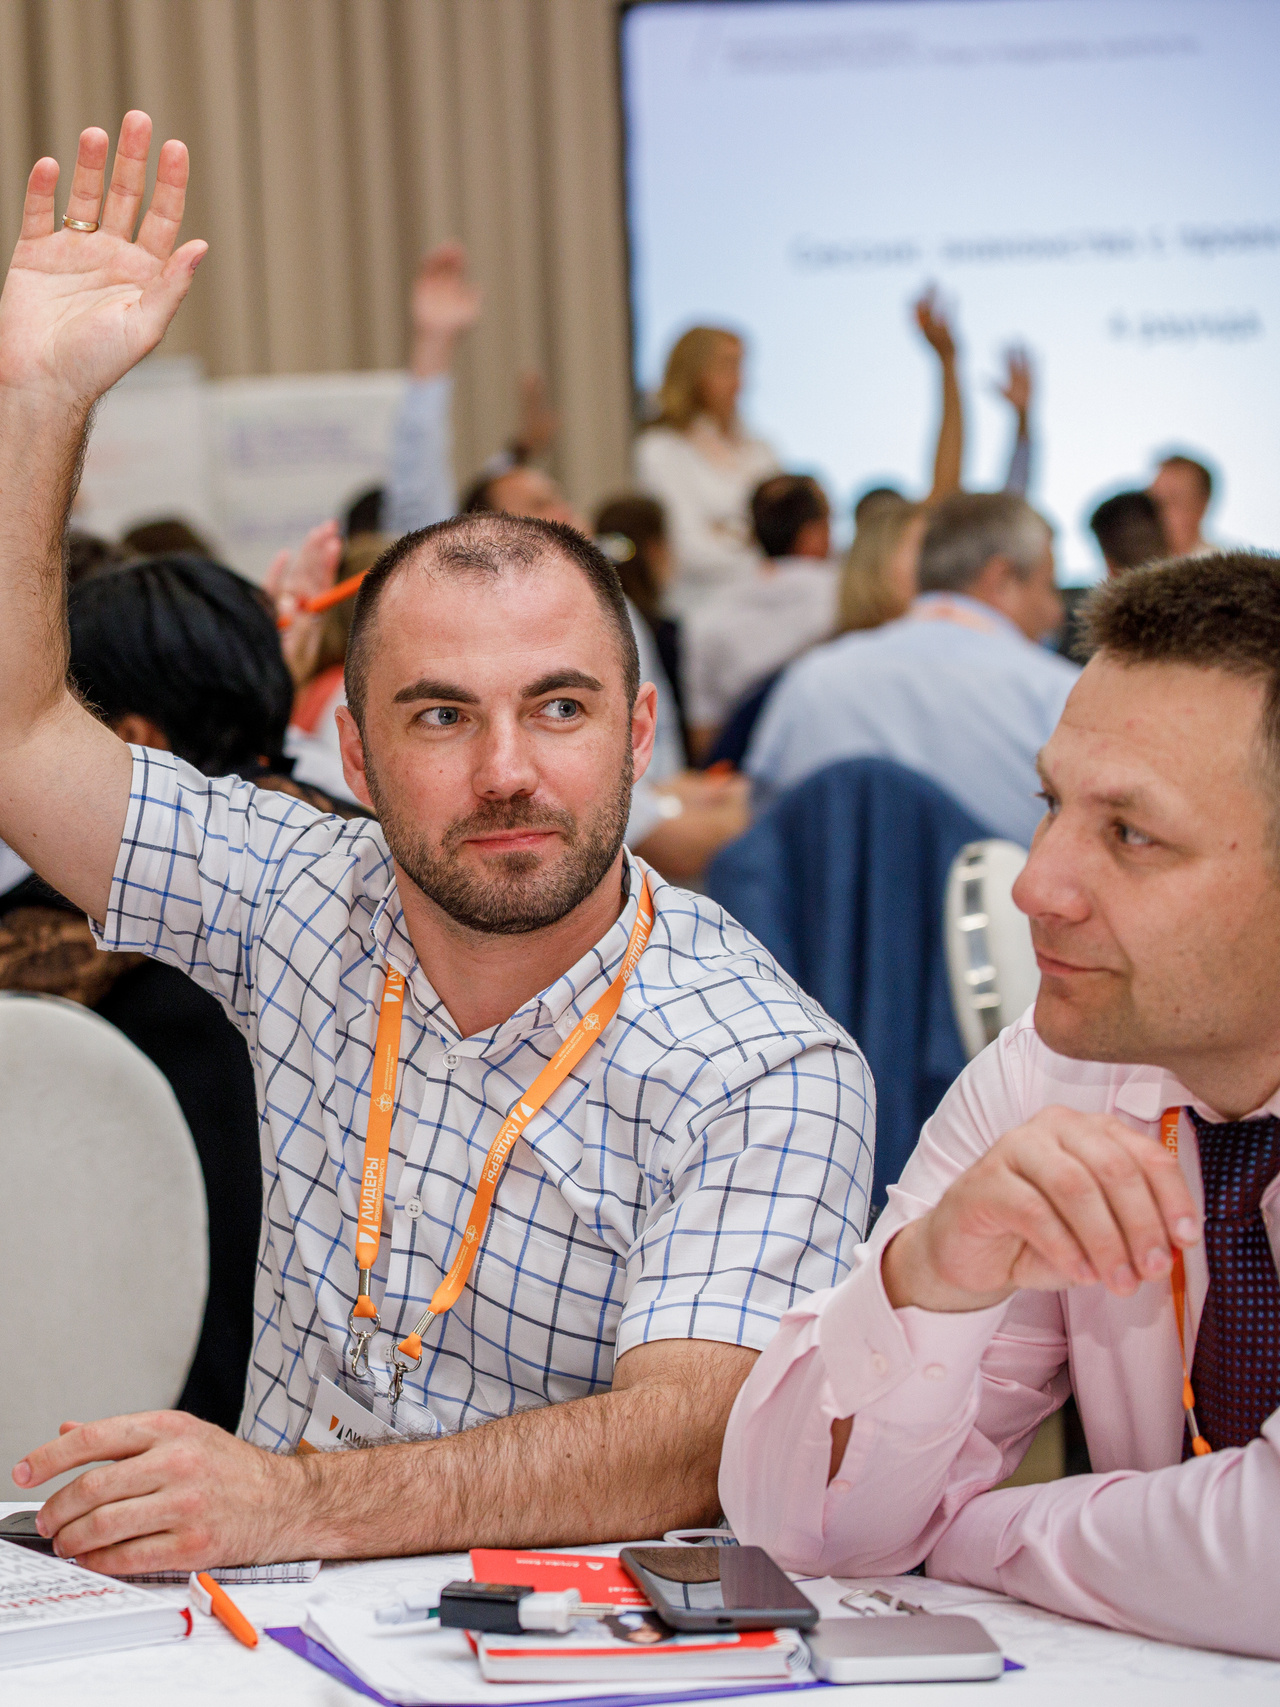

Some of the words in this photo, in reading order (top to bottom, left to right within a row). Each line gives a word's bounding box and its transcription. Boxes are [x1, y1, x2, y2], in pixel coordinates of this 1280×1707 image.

[621, 929, 648, 984] ЛИДЕРЫ
[485, 1123, 519, 1185] ЛИДЕРЫ
[361, 1156, 380, 1221] ЛИДЕРЫ
